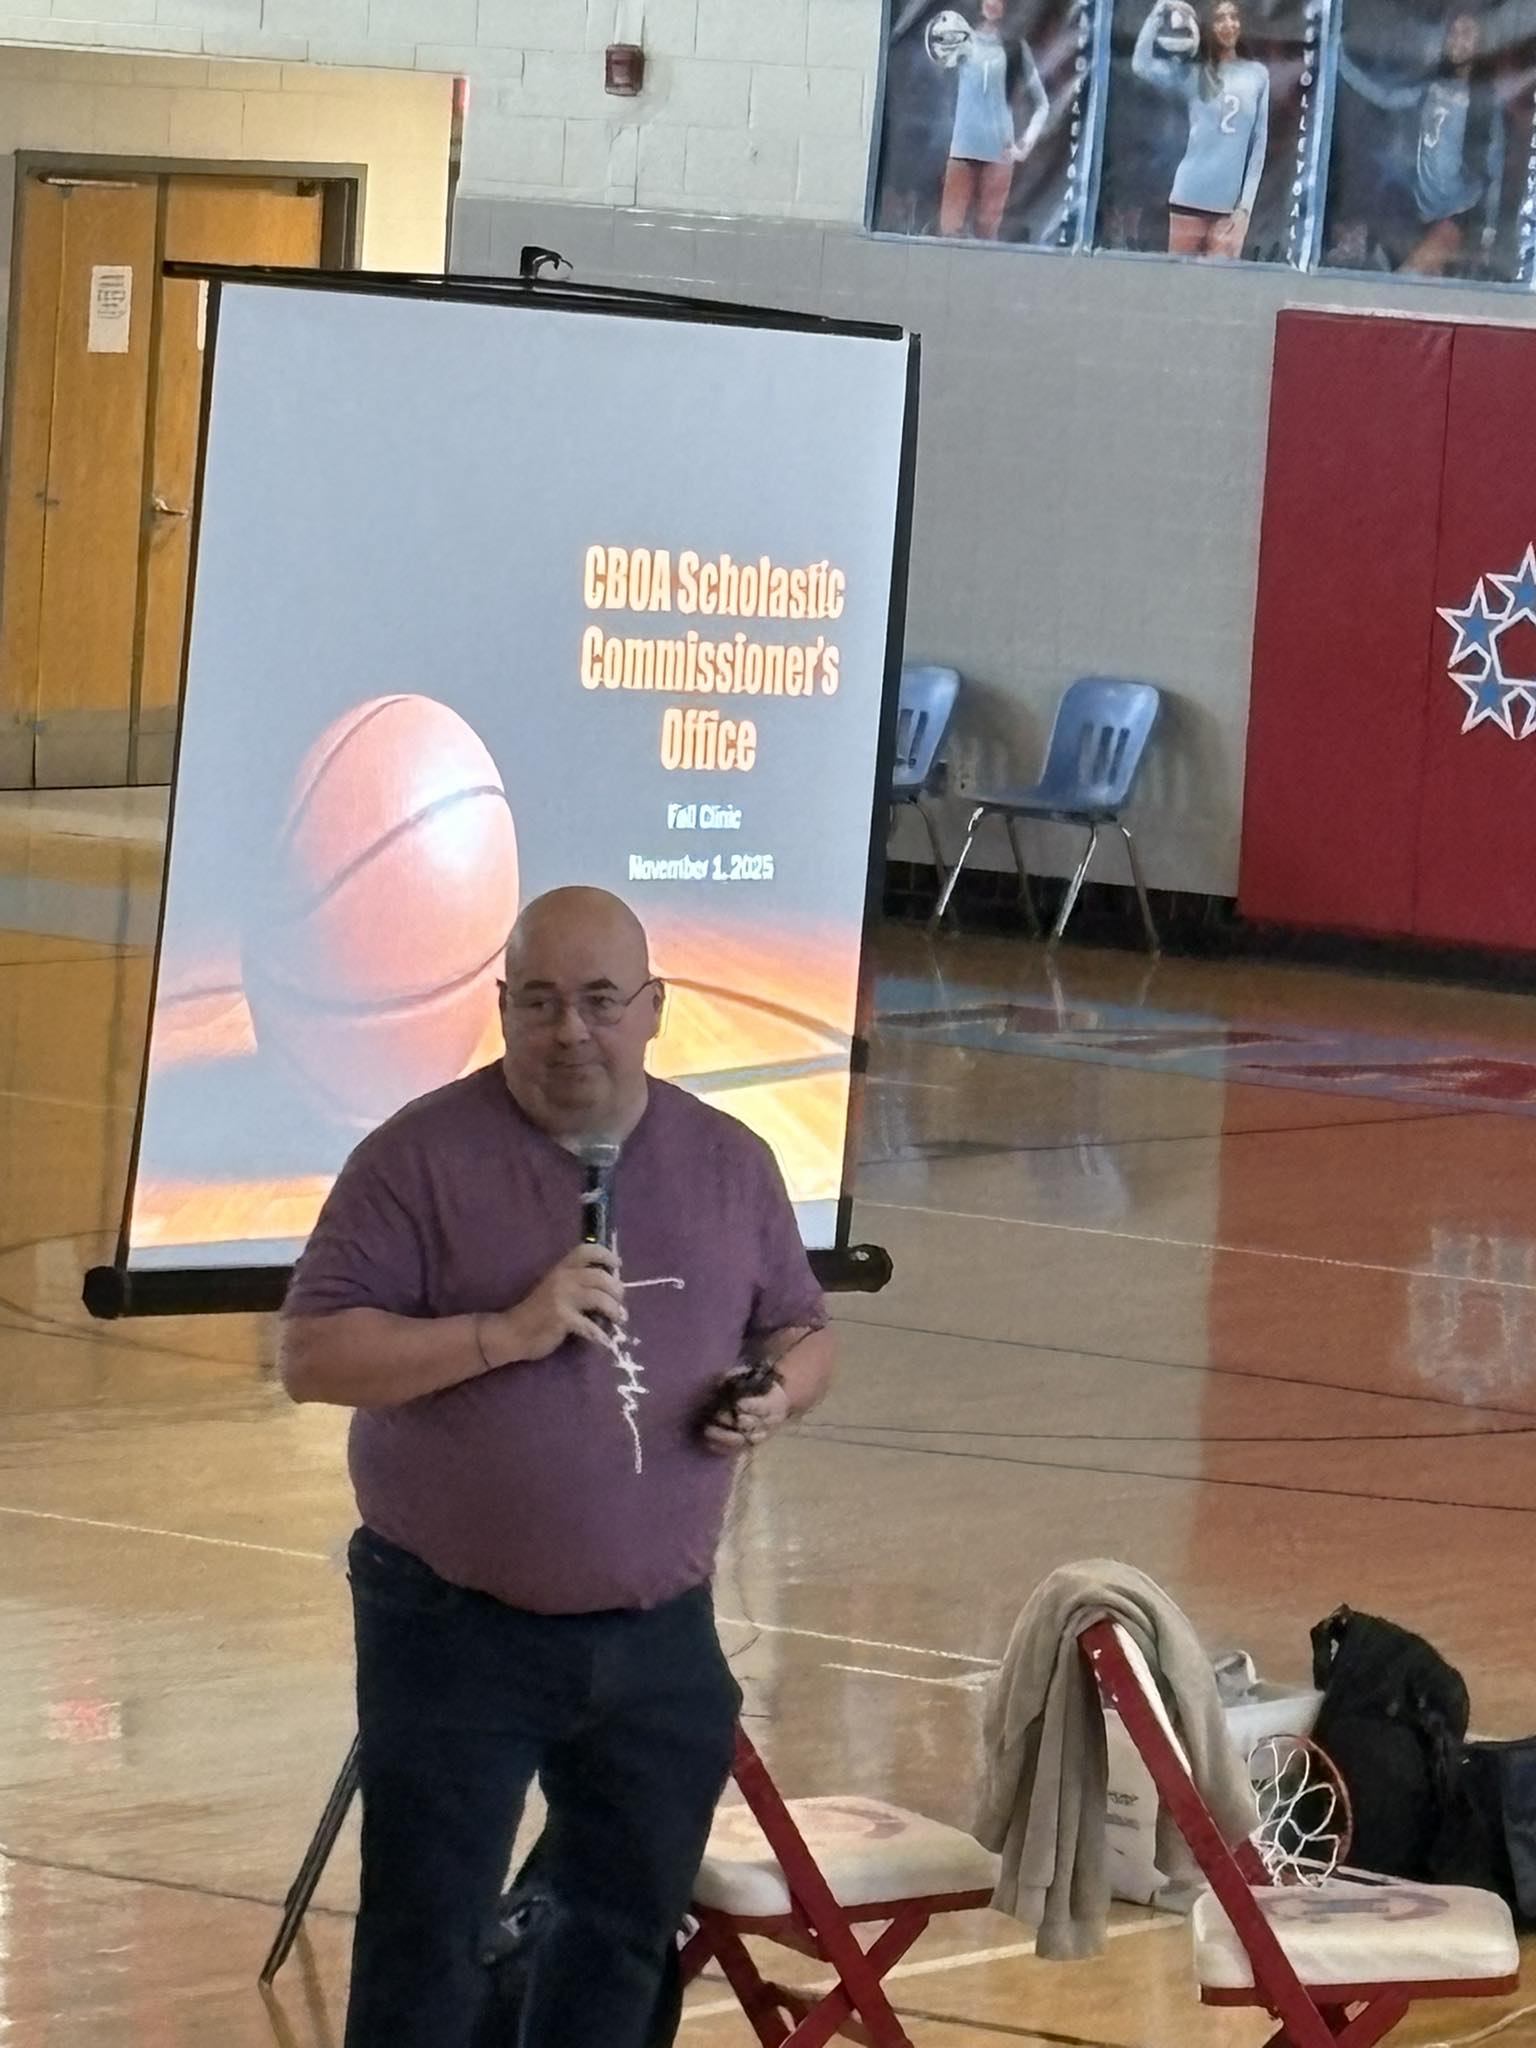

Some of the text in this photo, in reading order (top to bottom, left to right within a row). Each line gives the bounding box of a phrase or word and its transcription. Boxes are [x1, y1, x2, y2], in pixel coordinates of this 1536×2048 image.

[1220, 94, 1240, 133] 2
[584, 545, 846, 619] CBOA Scholastic
[581, 625, 840, 697] Commissioner's
[660, 708, 757, 772] Office
[667, 803, 742, 829] Fall Clinic
[628, 854, 709, 881] November
